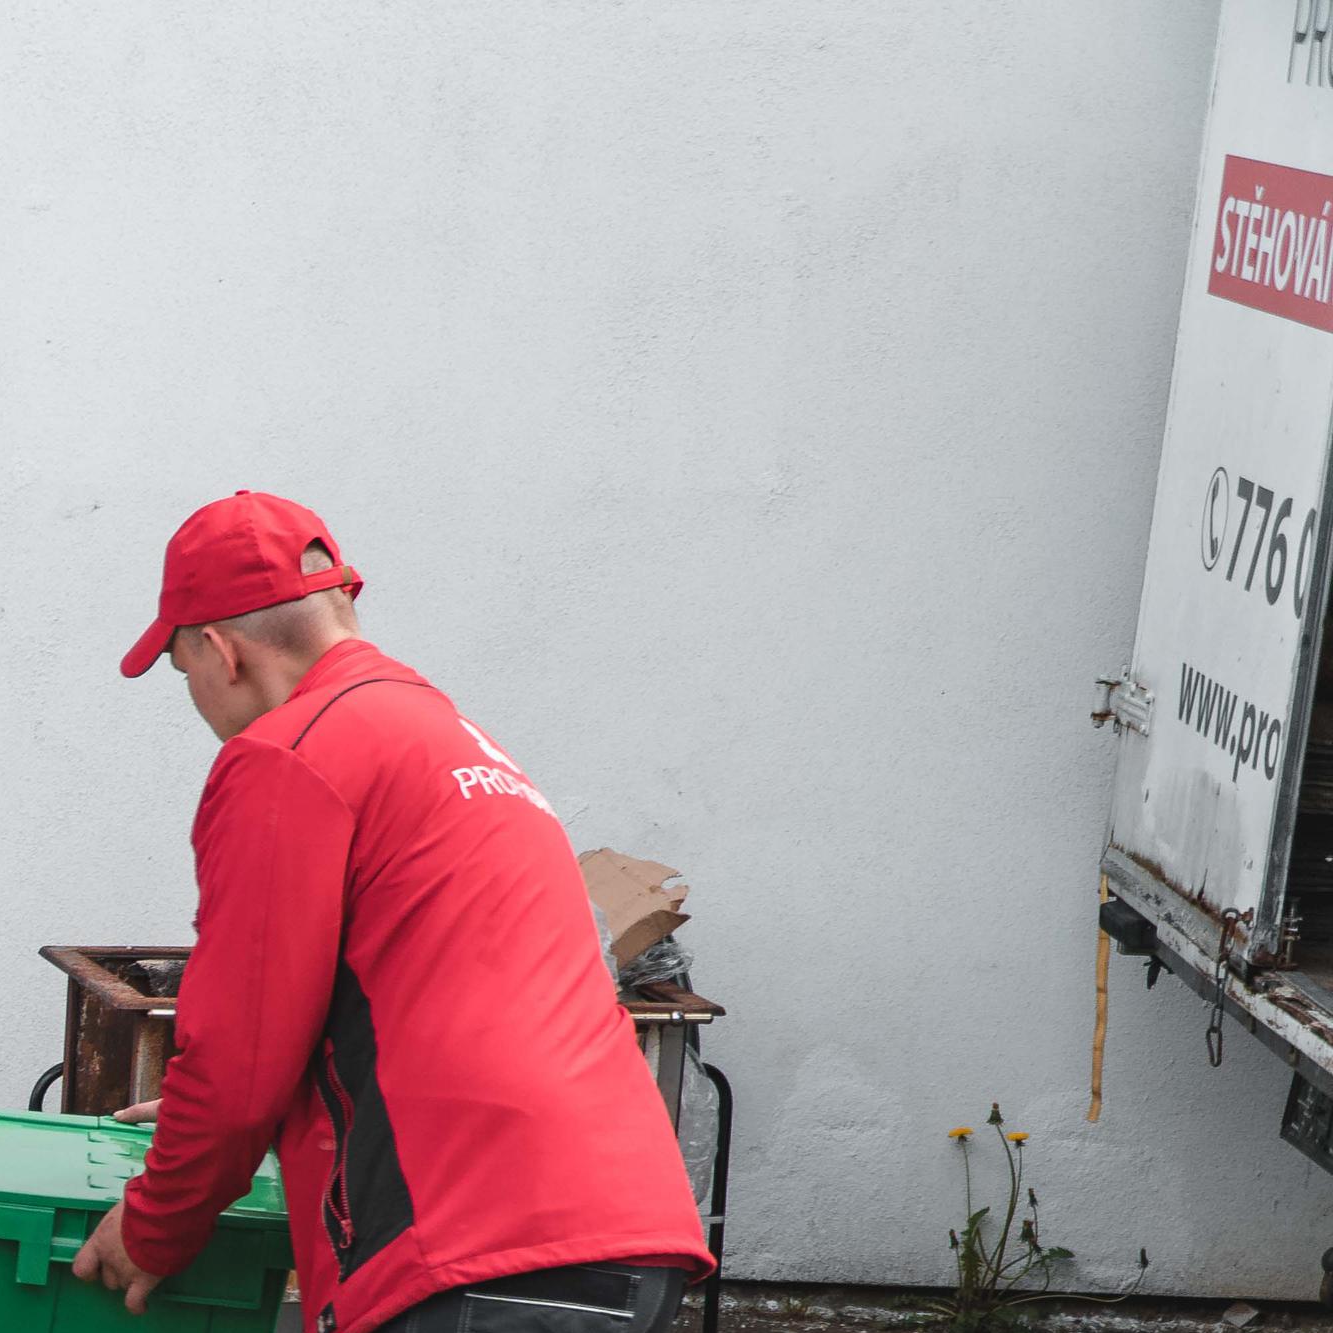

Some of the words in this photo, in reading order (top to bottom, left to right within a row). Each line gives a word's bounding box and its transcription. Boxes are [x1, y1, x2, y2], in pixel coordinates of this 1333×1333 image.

[1286, 0, 1333, 88] PR
[1215, 185, 1333, 304] STĚHOVÁ
[1225, 483, 1293, 606] 776
[1178, 662, 1281, 783] www.pro
